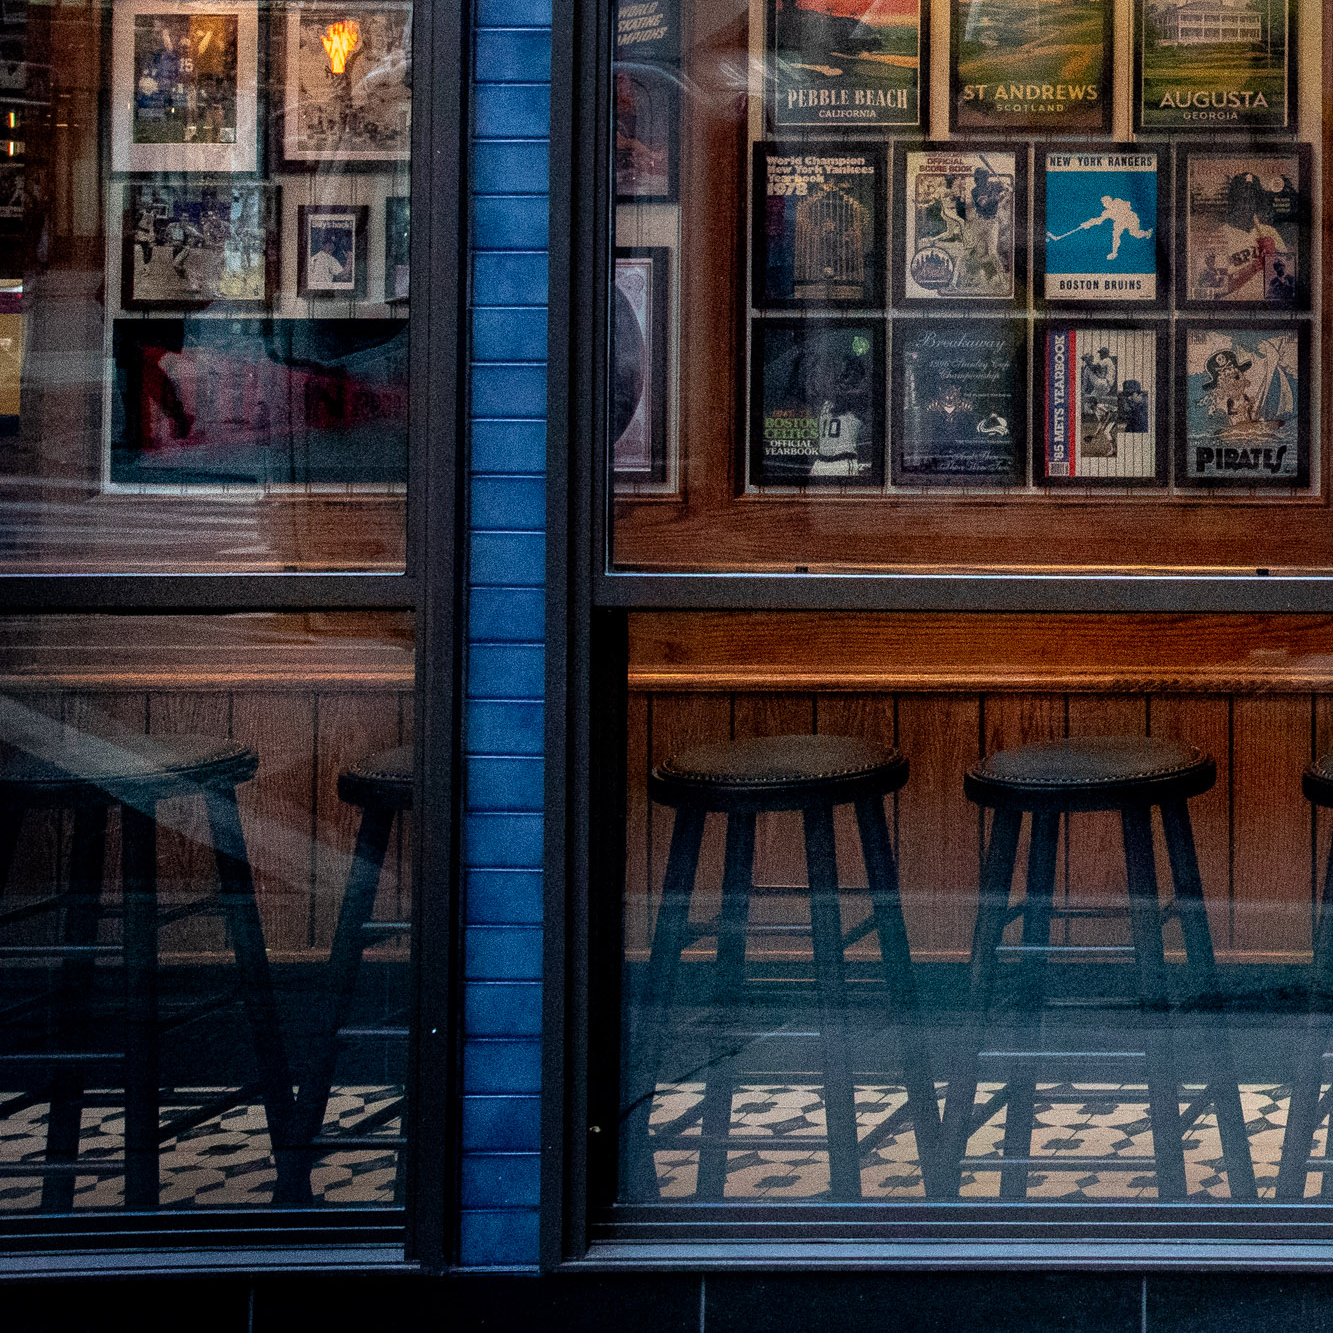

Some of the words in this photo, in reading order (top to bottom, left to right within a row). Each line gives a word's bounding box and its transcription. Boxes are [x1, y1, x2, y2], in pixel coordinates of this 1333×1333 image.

[963, 84, 988, 100] ST
[995, 84, 1098, 100] ANDREWS
[787, 88, 849, 109] PEBBLE
[854, 88, 907, 109] BEACH
[1160, 91, 1269, 108] AUGUSTA
[996, 104, 1065, 112] SCOTLAND
[818, 109, 877, 118] CALIFORNIA
[1183, 111, 1239, 120] GEORGIA
[766, 155, 803, 165] World
[805, 155, 865, 166] Champion
[927, 157, 964, 165] OFFICIAL
[1050, 157, 1071, 166] NEW
[1078, 157, 1102, 166] YORK
[1108, 156, 1153, 166] RANGERS
[767, 165, 793, 174] New
[795, 165, 822, 174] York
[824, 165, 875, 174] Yankees
[1059, 280, 1099, 290] BOSTON
[1104, 280, 1142, 290] BRUINS
[915, 331, 1007, 352] Breakaway
[1053, 334, 1066, 405] YEARBOOK
[765, 418, 818, 428] BOSTON
[1053, 407, 1066, 442] METS
[764, 428, 819, 439] CELTICS
[770, 439, 812, 447] OFFICIAL
[765, 447, 819, 456] YEARBOOK
[1196, 446, 1288, 473] PIRATES
